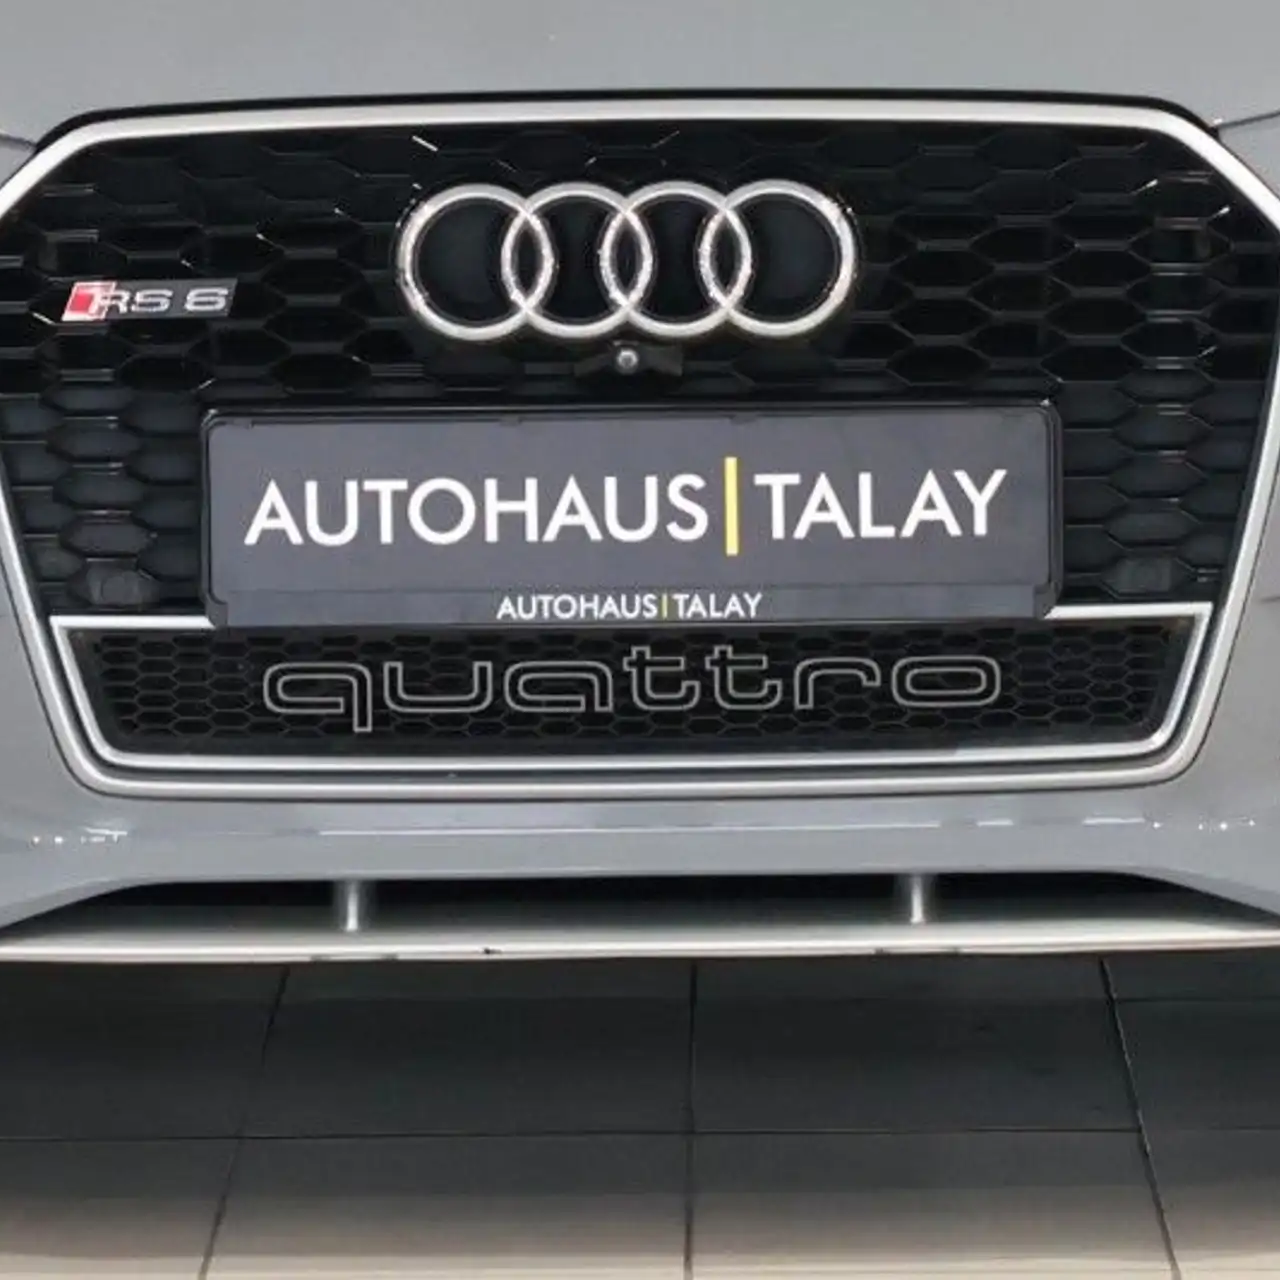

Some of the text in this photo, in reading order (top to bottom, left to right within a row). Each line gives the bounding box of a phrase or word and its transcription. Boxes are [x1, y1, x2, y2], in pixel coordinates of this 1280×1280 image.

[89, 286, 230, 315] RS 6
[243, 468, 1008, 547] AUTOHAUS TALAY
[496, 592, 763, 620] AUTOHAUS TALAY
[263, 645, 1002, 732] quattro
